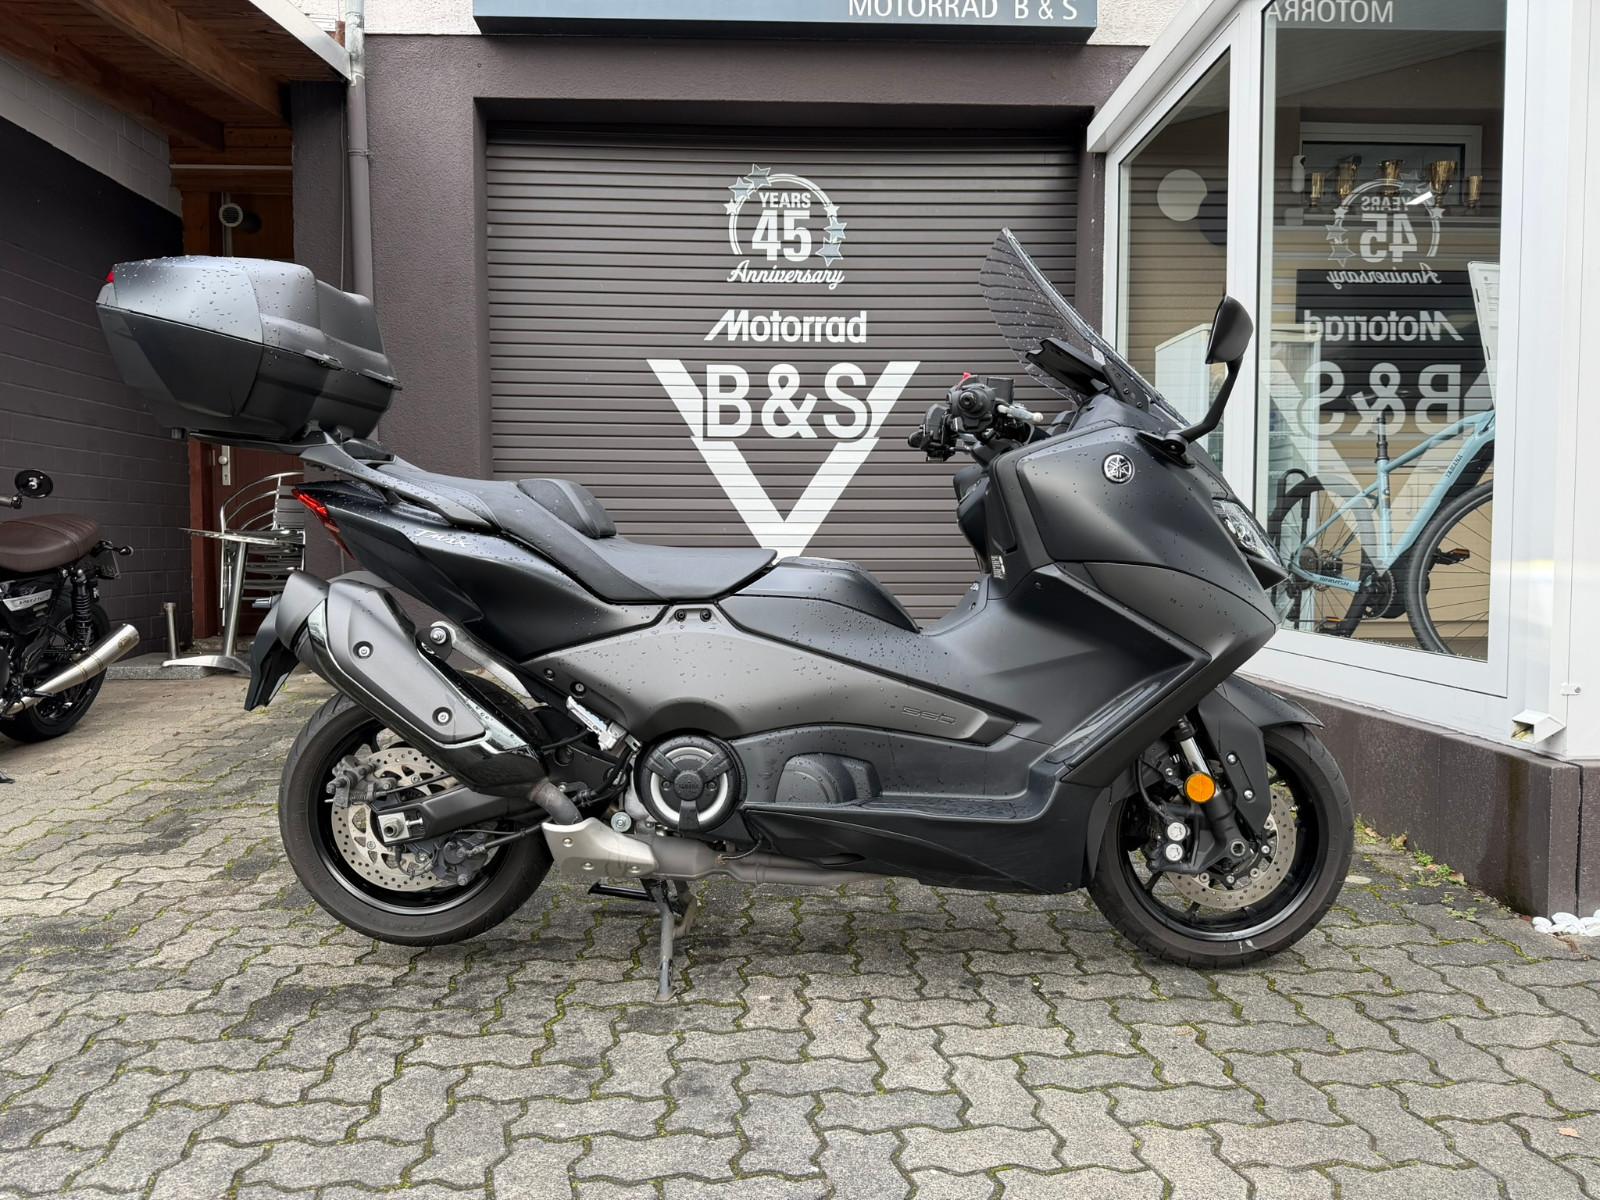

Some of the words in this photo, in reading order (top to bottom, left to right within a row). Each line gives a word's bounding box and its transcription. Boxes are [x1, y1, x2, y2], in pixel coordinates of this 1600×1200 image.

[849, 0, 998, 18] MOTORRAD
[1015, 0, 1029, 19] B
[1038, 0, 1054, 20] &
[1063, 0, 1077, 20] S
[759, 192, 811, 208] YEARS
[752, 210, 812, 261] 45
[727, 260, 845, 290] Anniversary
[704, 309, 867, 343] Motorrad
[706, 362, 868, 439] B&S
